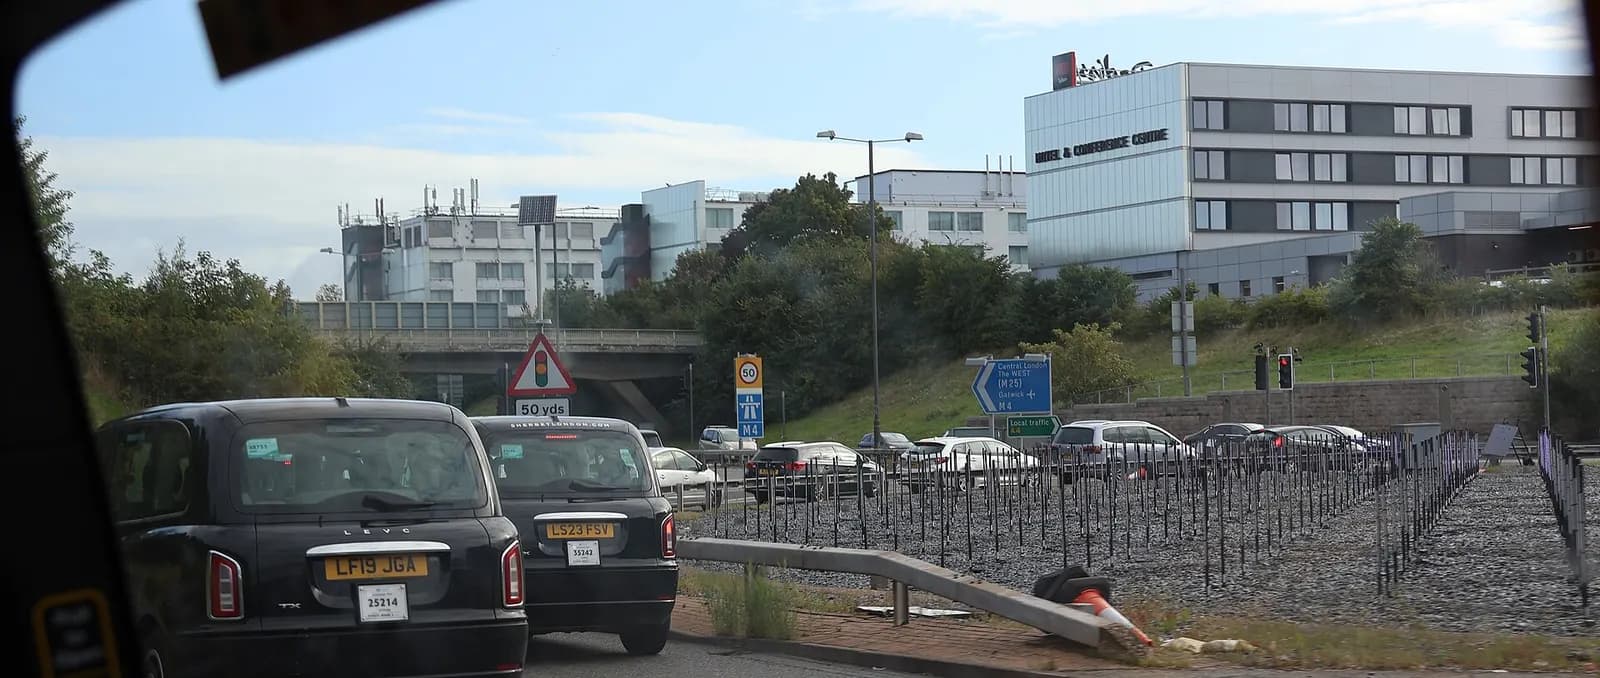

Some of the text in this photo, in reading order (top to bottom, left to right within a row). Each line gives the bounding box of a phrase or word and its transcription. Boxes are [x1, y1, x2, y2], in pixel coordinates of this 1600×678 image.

[1074, 136, 1129, 156] CONFERENCE
[1132, 128, 1168, 145] CENTRE
[998, 361, 1048, 370] Central London
[742, 368, 755, 377] 50
[998, 379, 1022, 389] (M25)
[999, 391, 1024, 399] Gatwick
[521, 404, 565, 416] 50 yds
[999, 402, 1012, 410] M4
[743, 424, 758, 436] M4
[344, 527, 410, 536] LEVC
[551, 524, 609, 536] LS23 FSV
[336, 556, 417, 576] LF19 JGA
[368, 598, 398, 608] 25214
